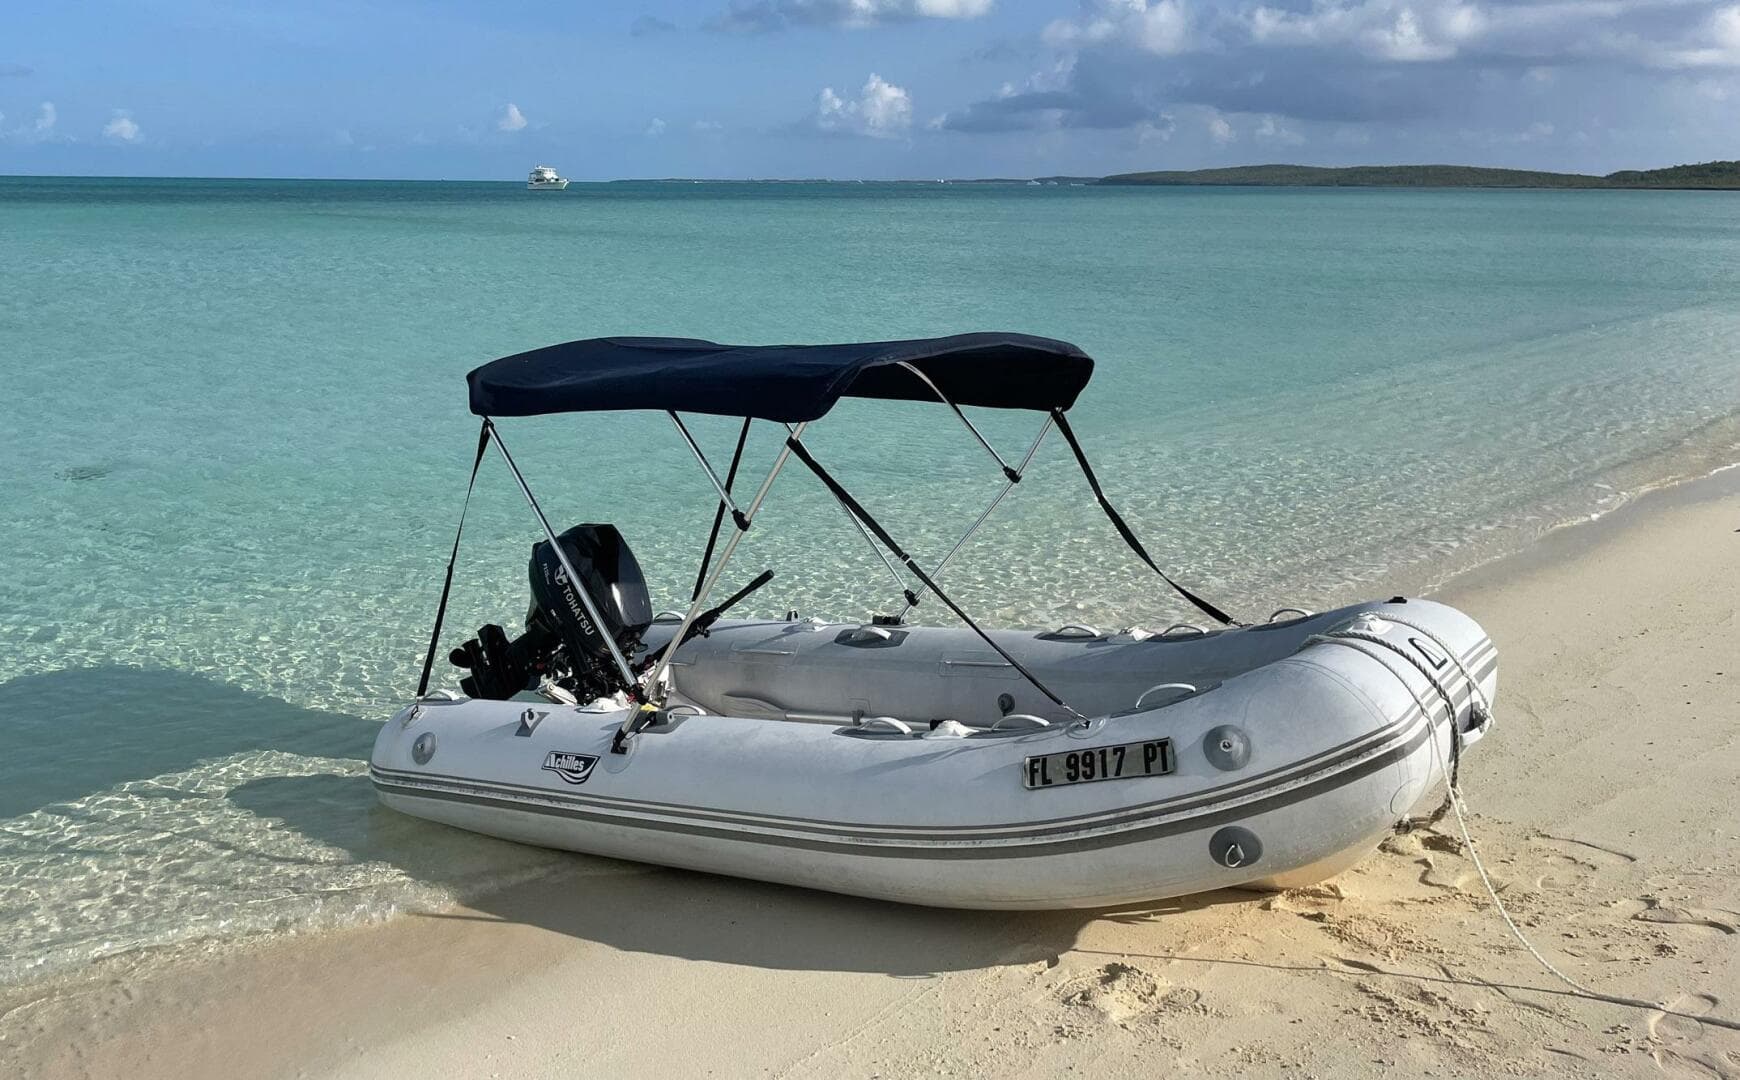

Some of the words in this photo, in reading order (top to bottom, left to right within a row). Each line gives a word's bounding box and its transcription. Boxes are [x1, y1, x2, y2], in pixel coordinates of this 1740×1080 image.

[562, 585, 595, 636] TOHATSU
[545, 753, 585, 771] Achilles
[1029, 757, 1053, 786] FL
[1065, 746, 1126, 782] 9917
[1143, 740, 1169, 774] PT
